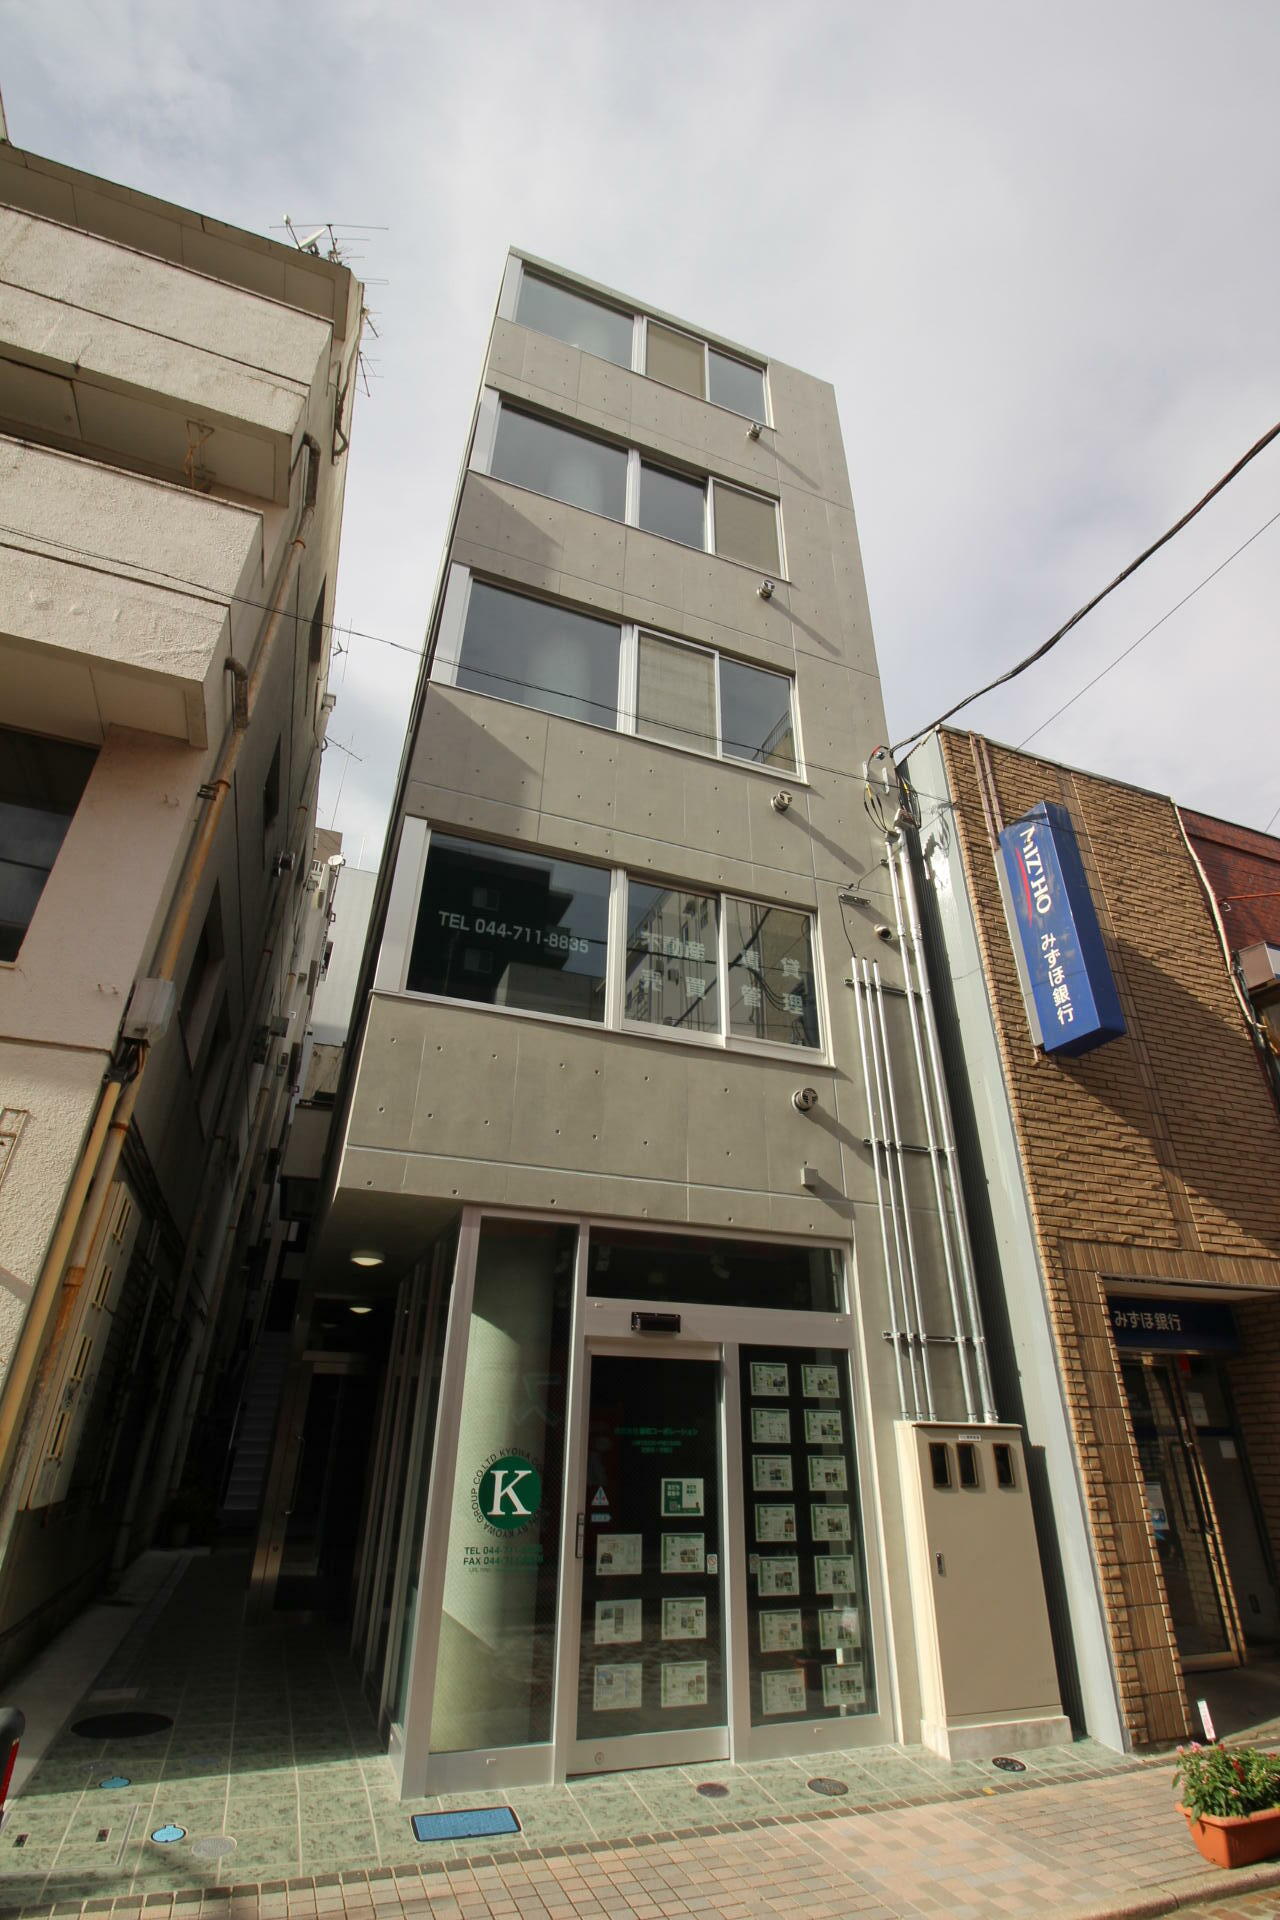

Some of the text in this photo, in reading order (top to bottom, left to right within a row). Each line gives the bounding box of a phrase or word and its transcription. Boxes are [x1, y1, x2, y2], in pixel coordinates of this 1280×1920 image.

[438, 910, 589, 953] TEL 044-711-8835
[641, 931, 705, 961] 不動産
[1041, 933, 1074, 1026] みずほ銀行
[1113, 1310, 1182, 1332] みずほ銀行
[471, 1487, 484, 1524] GROUP
[487, 1470, 532, 1515] K
[463, 1557, 481, 1566] FAX
[464, 1546, 480, 1555] TEL
